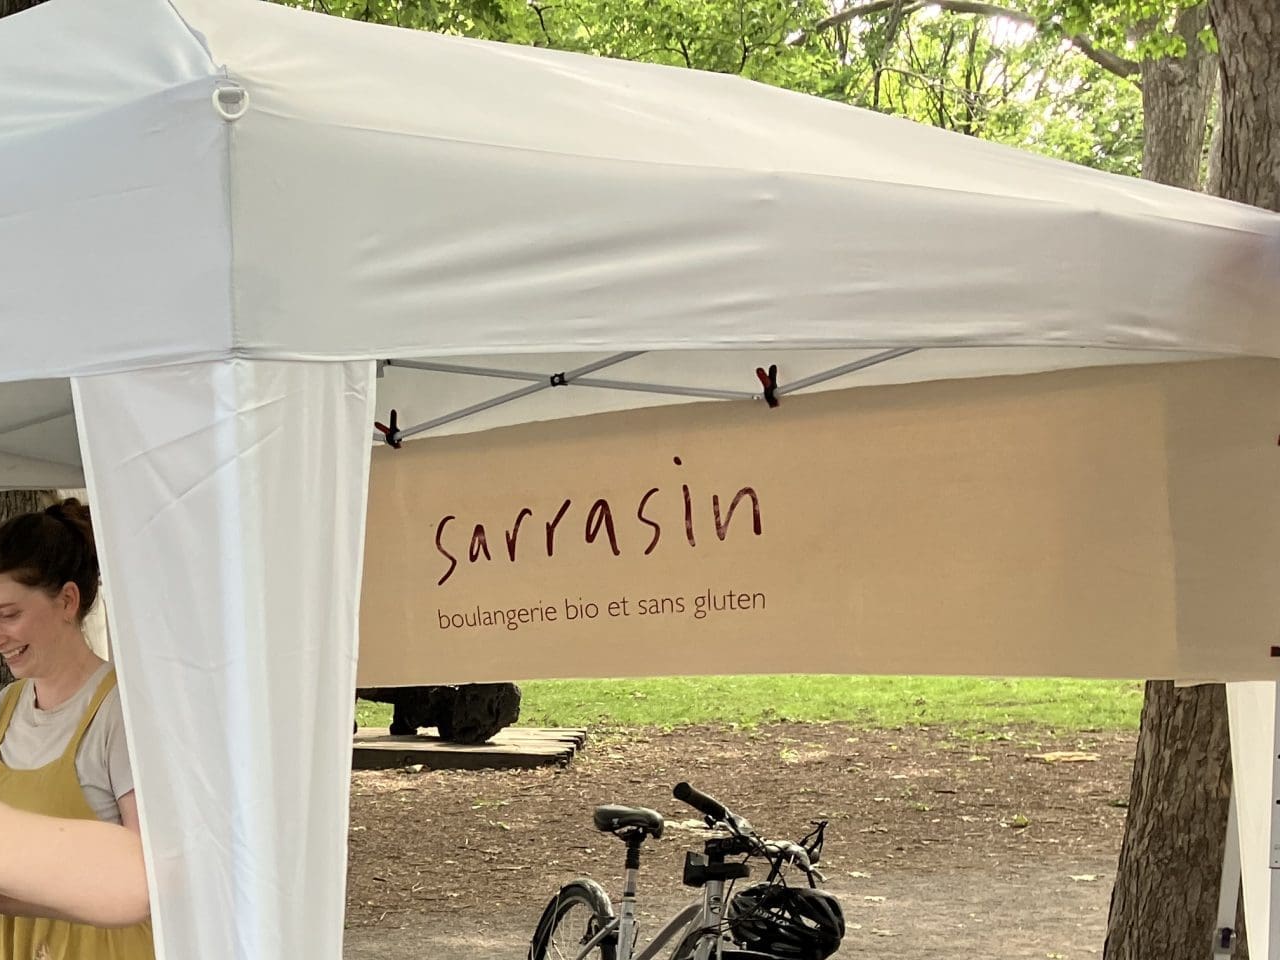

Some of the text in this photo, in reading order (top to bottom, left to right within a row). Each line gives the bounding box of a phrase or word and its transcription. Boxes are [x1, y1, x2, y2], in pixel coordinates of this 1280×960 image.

[434, 456, 762, 586] sarrasin
[437, 588, 766, 631] boulangerie bio et sans gluten
